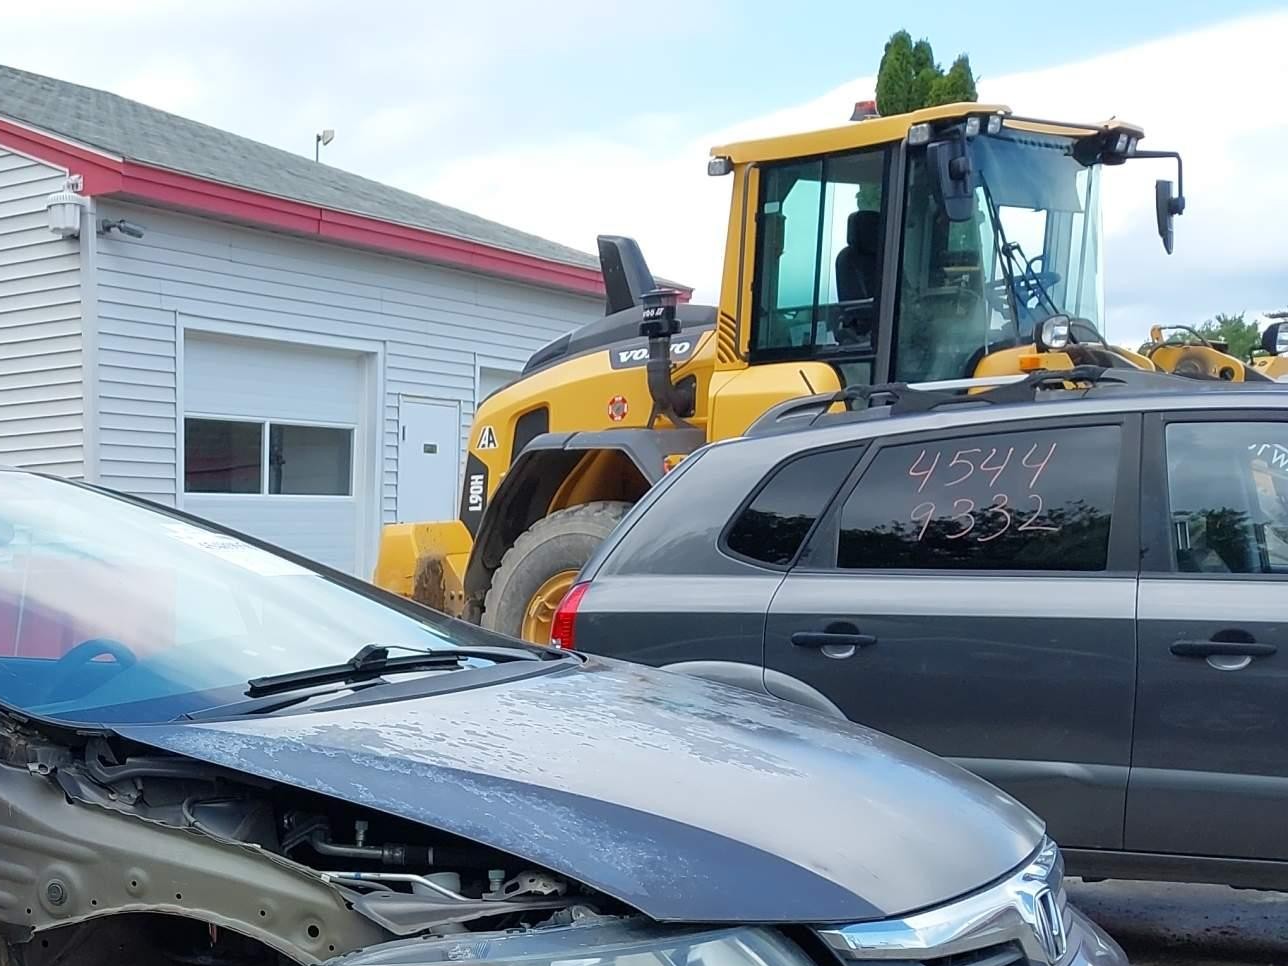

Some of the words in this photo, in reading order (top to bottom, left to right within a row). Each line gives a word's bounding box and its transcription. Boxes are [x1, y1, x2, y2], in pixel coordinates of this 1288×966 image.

[908, 442, 1057, 493] 4544
[468, 474, 484, 512] L90H
[910, 493, 1060, 542] 9332
